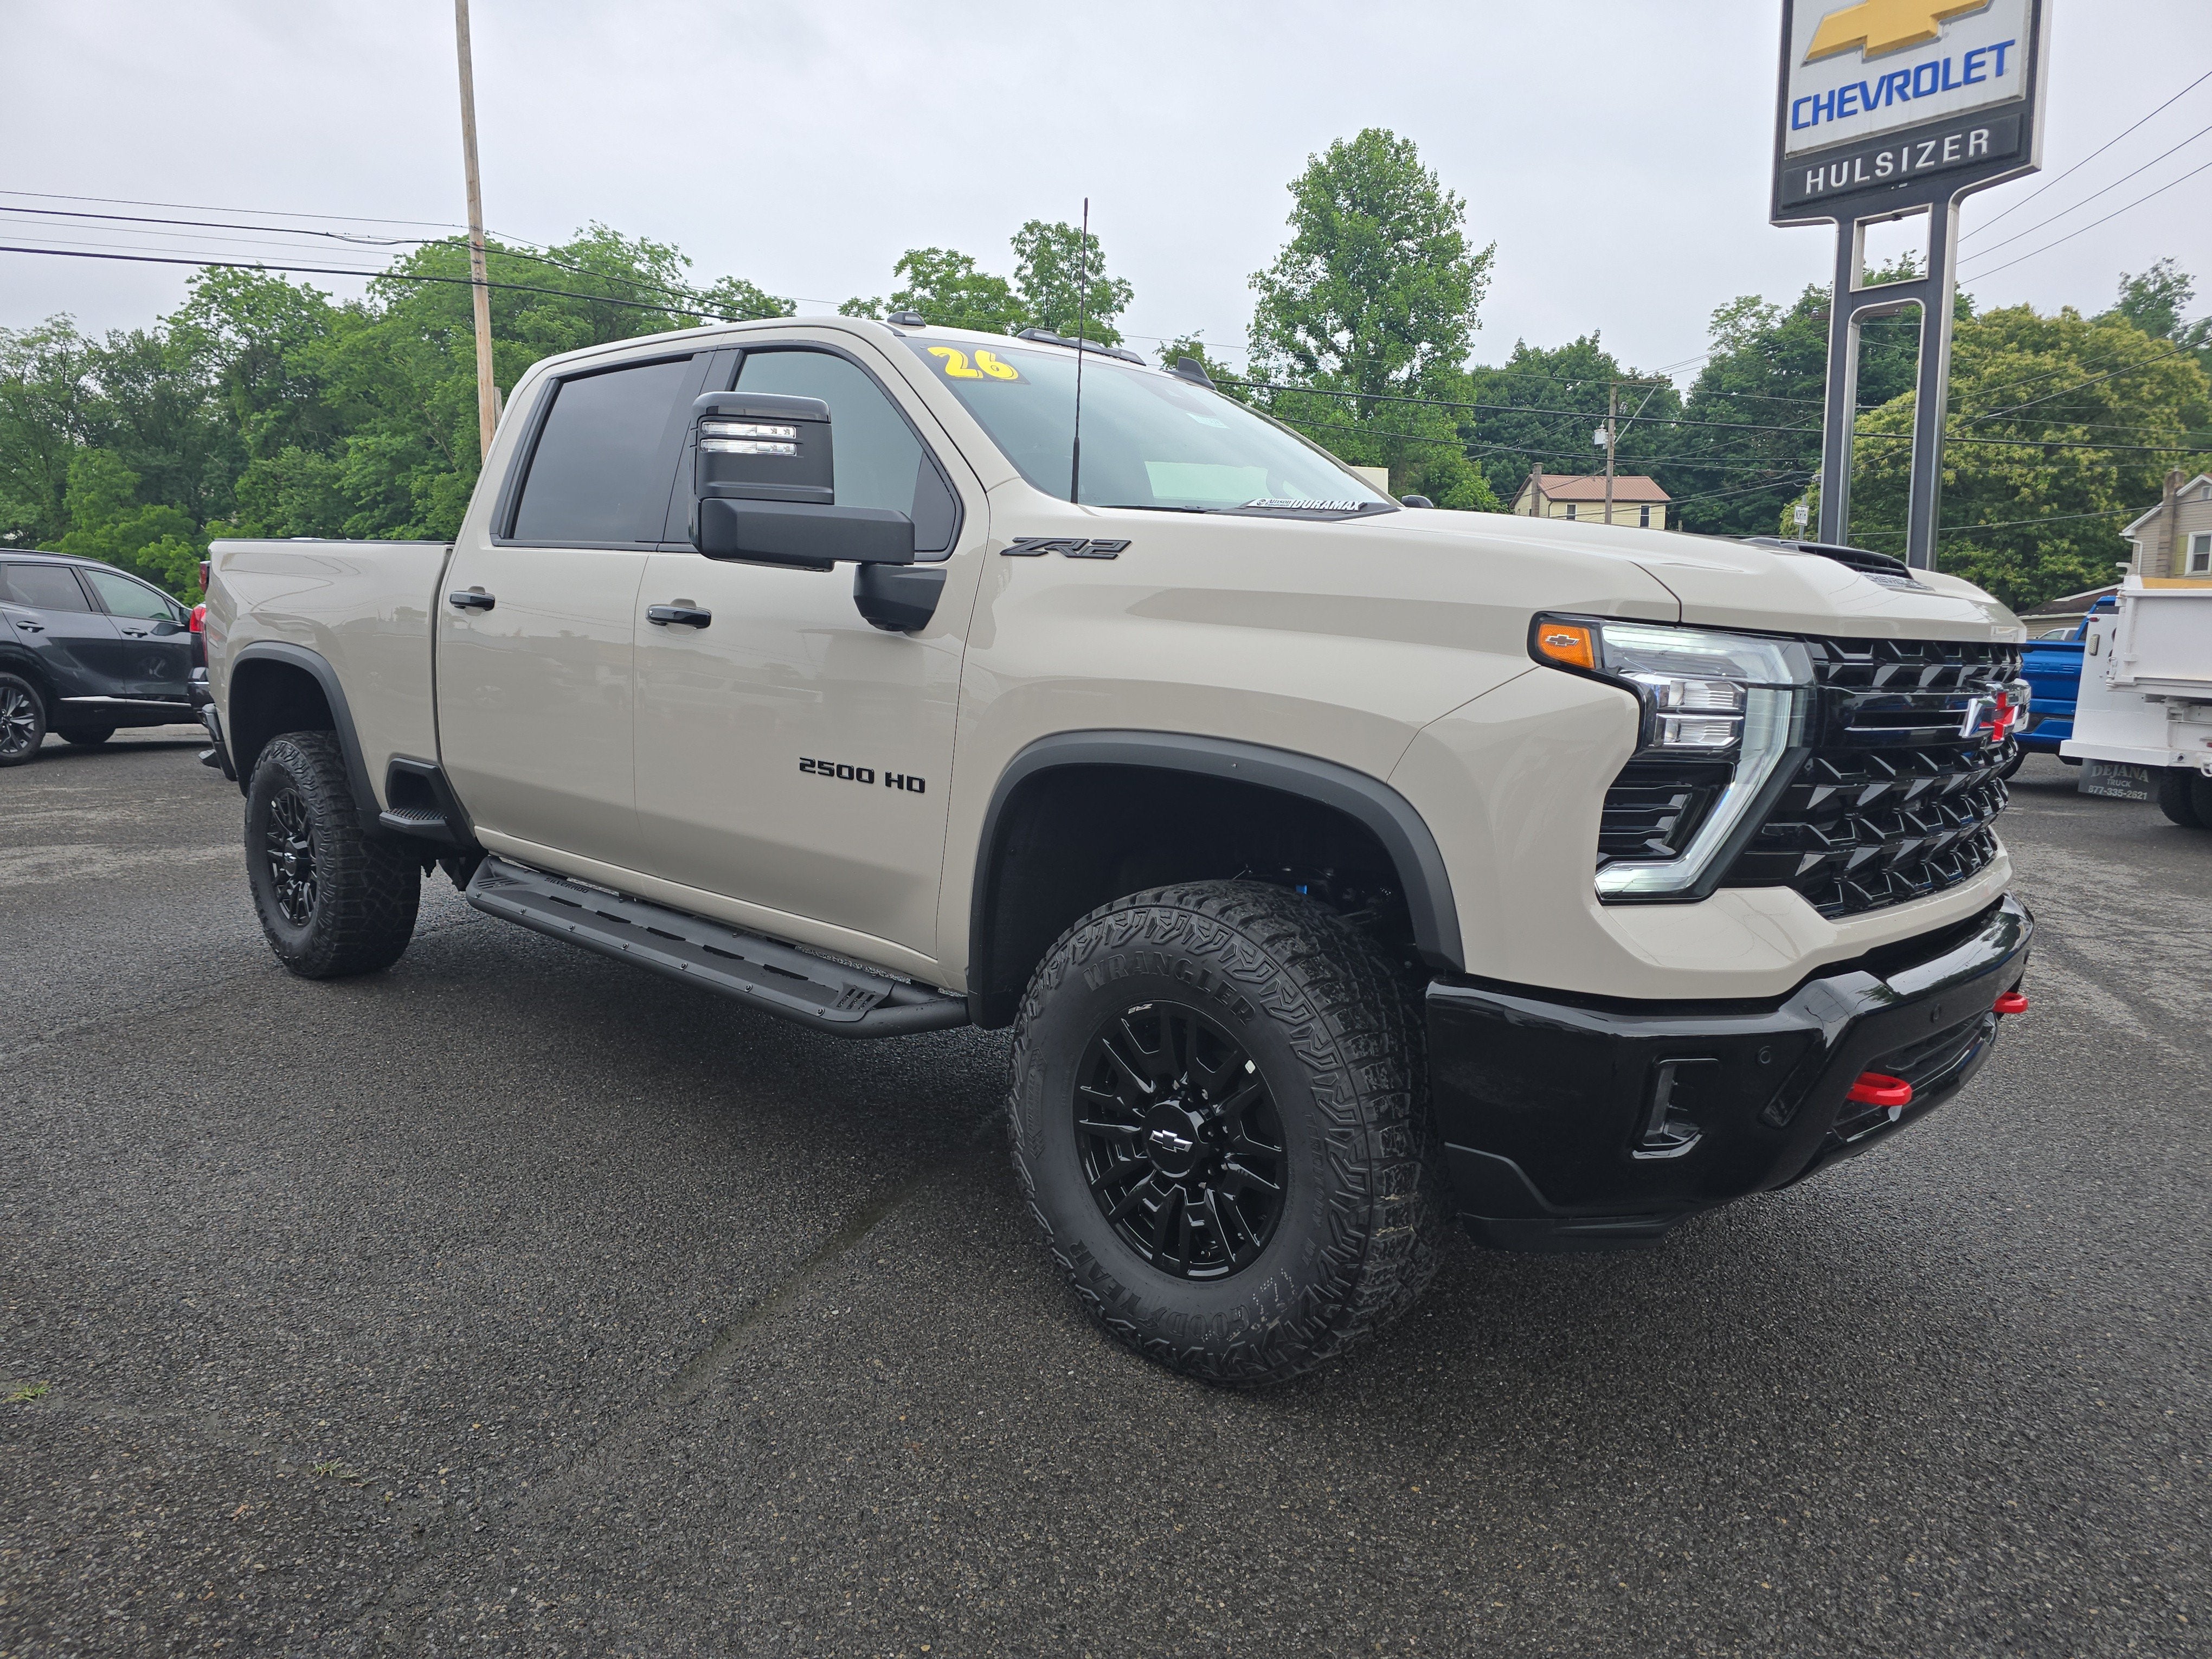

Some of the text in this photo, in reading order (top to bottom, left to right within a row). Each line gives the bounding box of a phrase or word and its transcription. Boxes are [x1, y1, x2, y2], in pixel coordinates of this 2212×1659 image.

[1792, 39, 2015, 130] CHEVROLET
[1805, 128, 1990, 195] HULSIZER
[927, 346, 1019, 380] 26
[1291, 499, 1366, 511] DURAMAX
[999, 537, 1132, 560] ZR2
[799, 757, 925, 793] 2500 HD
[2091, 764, 2149, 782] DEJANA
[2107, 779, 2132, 787] TRUCK
[2088, 785, 2147, 800] 877-335-2621
[544, 878, 589, 893] SILVERADO
[1082, 950, 1256, 1026] WRANGLER
